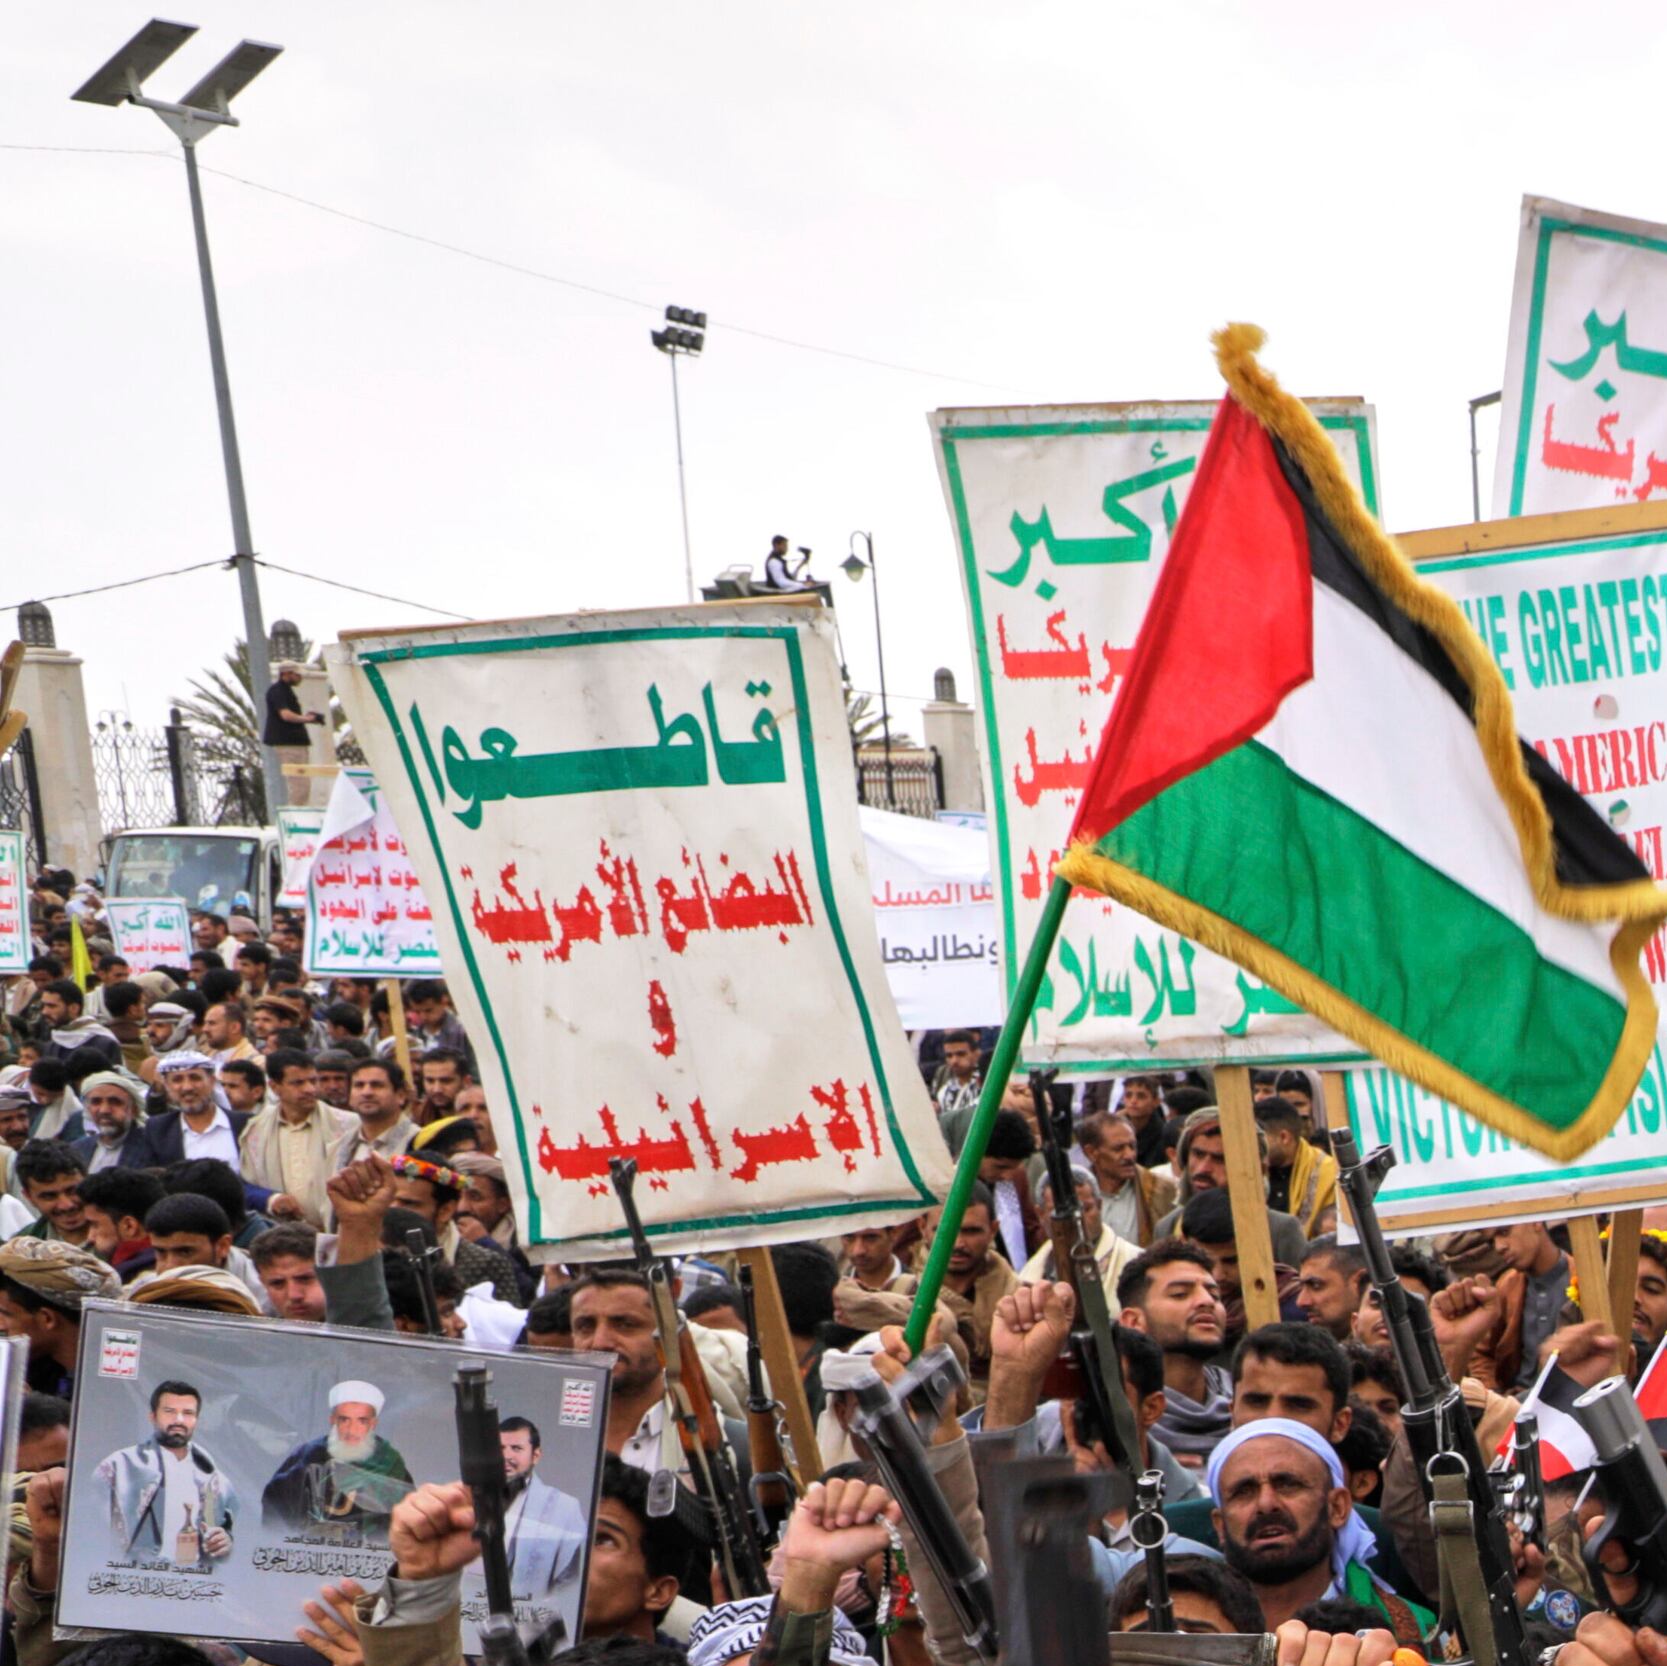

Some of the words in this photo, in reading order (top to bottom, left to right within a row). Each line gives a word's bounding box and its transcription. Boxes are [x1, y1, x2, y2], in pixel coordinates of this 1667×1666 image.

[408, 680, 788, 830] قاطعوا
[458, 836, 651, 964] الأمريكية
[655, 846, 814, 954] البضائع
